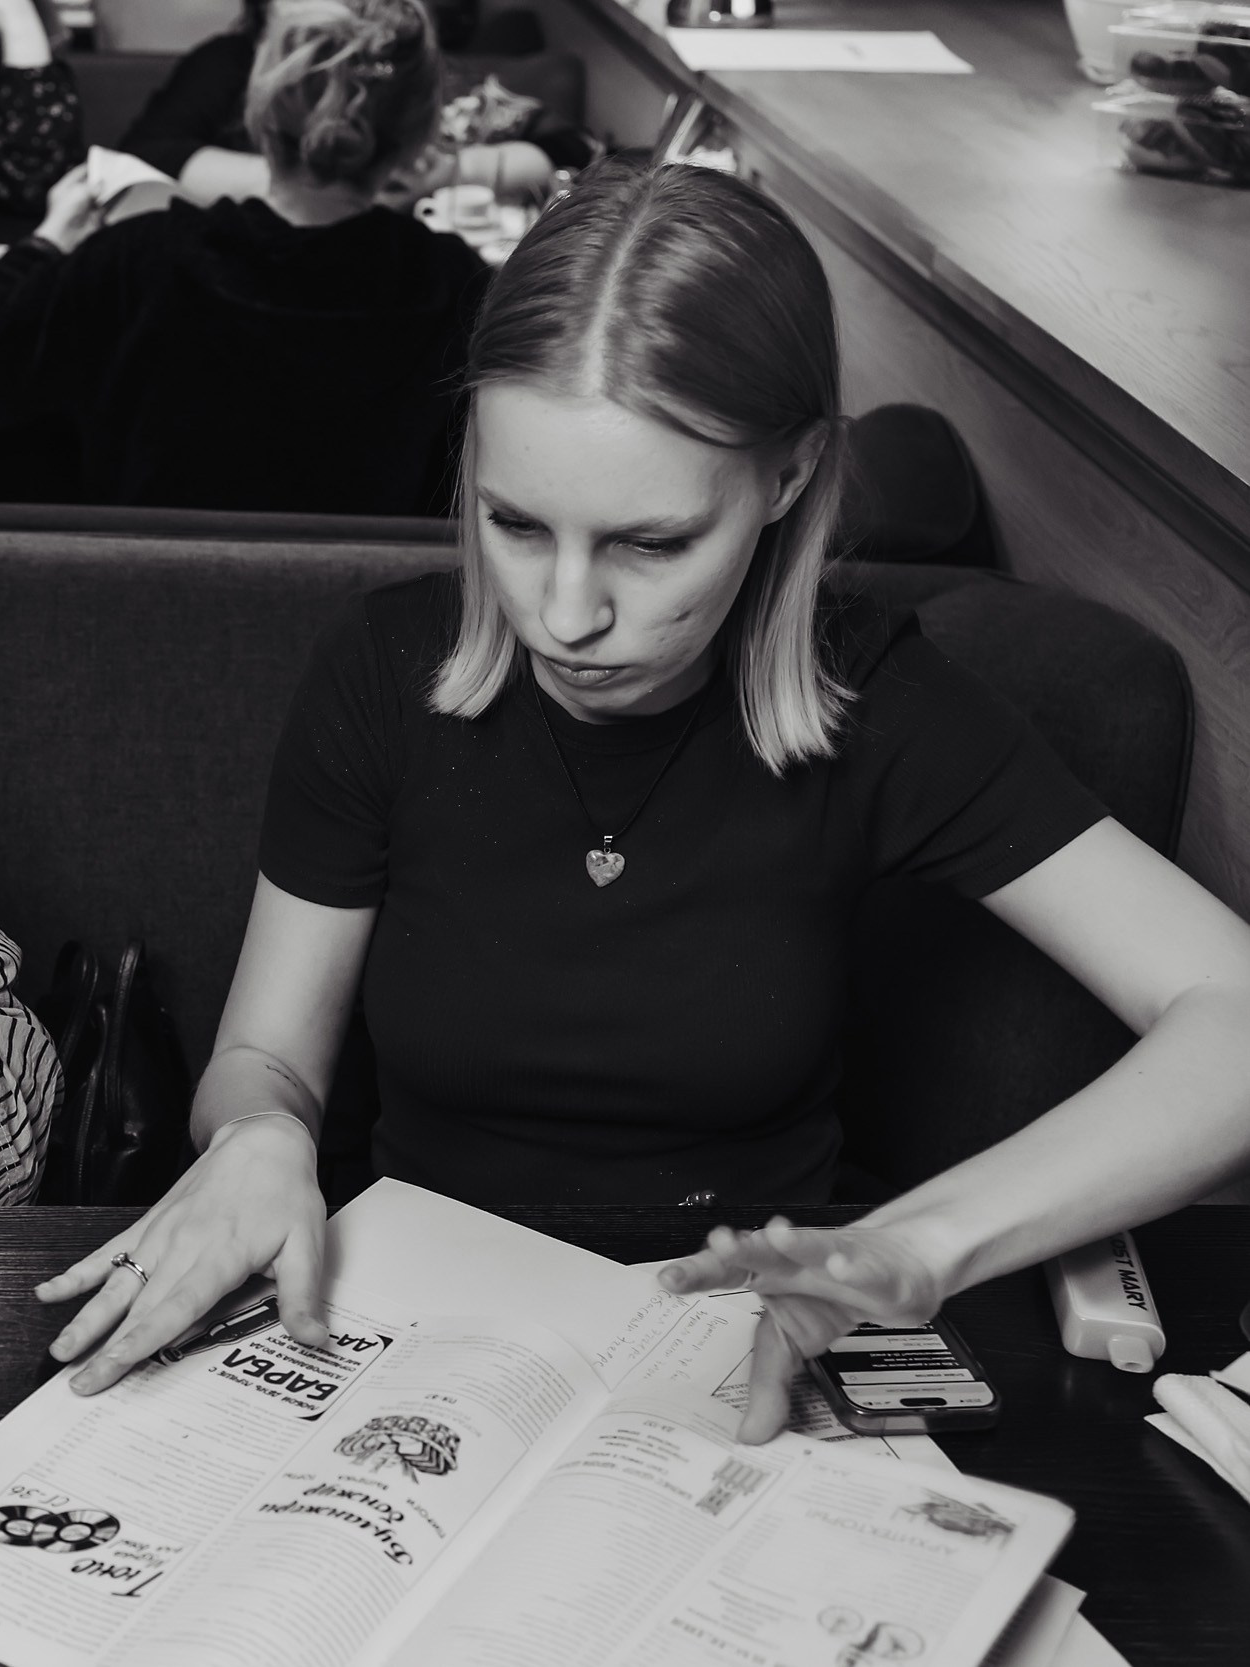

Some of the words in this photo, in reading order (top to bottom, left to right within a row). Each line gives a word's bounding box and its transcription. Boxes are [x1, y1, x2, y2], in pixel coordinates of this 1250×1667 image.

[1111, 1236, 1133, 1267] OST
[1117, 1271, 1147, 1310] MARY
[249, 1341, 276, 1355] ВОДА
[328, 1332, 378, 1354] ДА-
[221, 1347, 338, 1403] БАРБЛ
[275, 1351, 347, 1383] ГАЗИРОВАННАЯ
[255, 1384, 282, 1399] ДЕНЬ
[302, 1483, 403, 1525] бонжур
